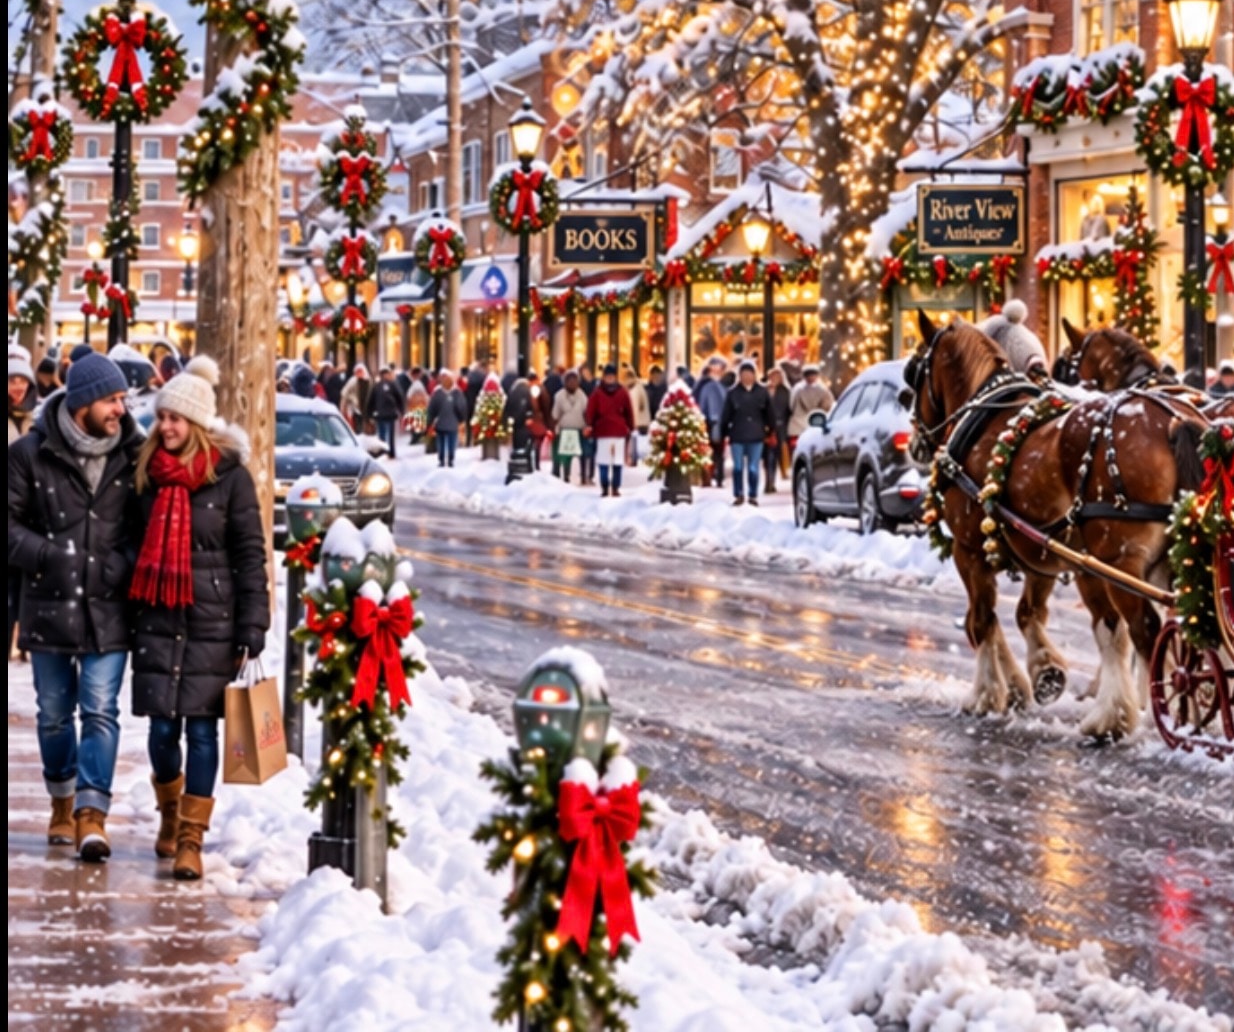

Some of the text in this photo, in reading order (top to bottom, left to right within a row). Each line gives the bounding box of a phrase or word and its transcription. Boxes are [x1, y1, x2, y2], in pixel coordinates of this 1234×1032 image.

[930, 197, 1015, 221] River View
[564, 228, 638, 250] BOOKS
